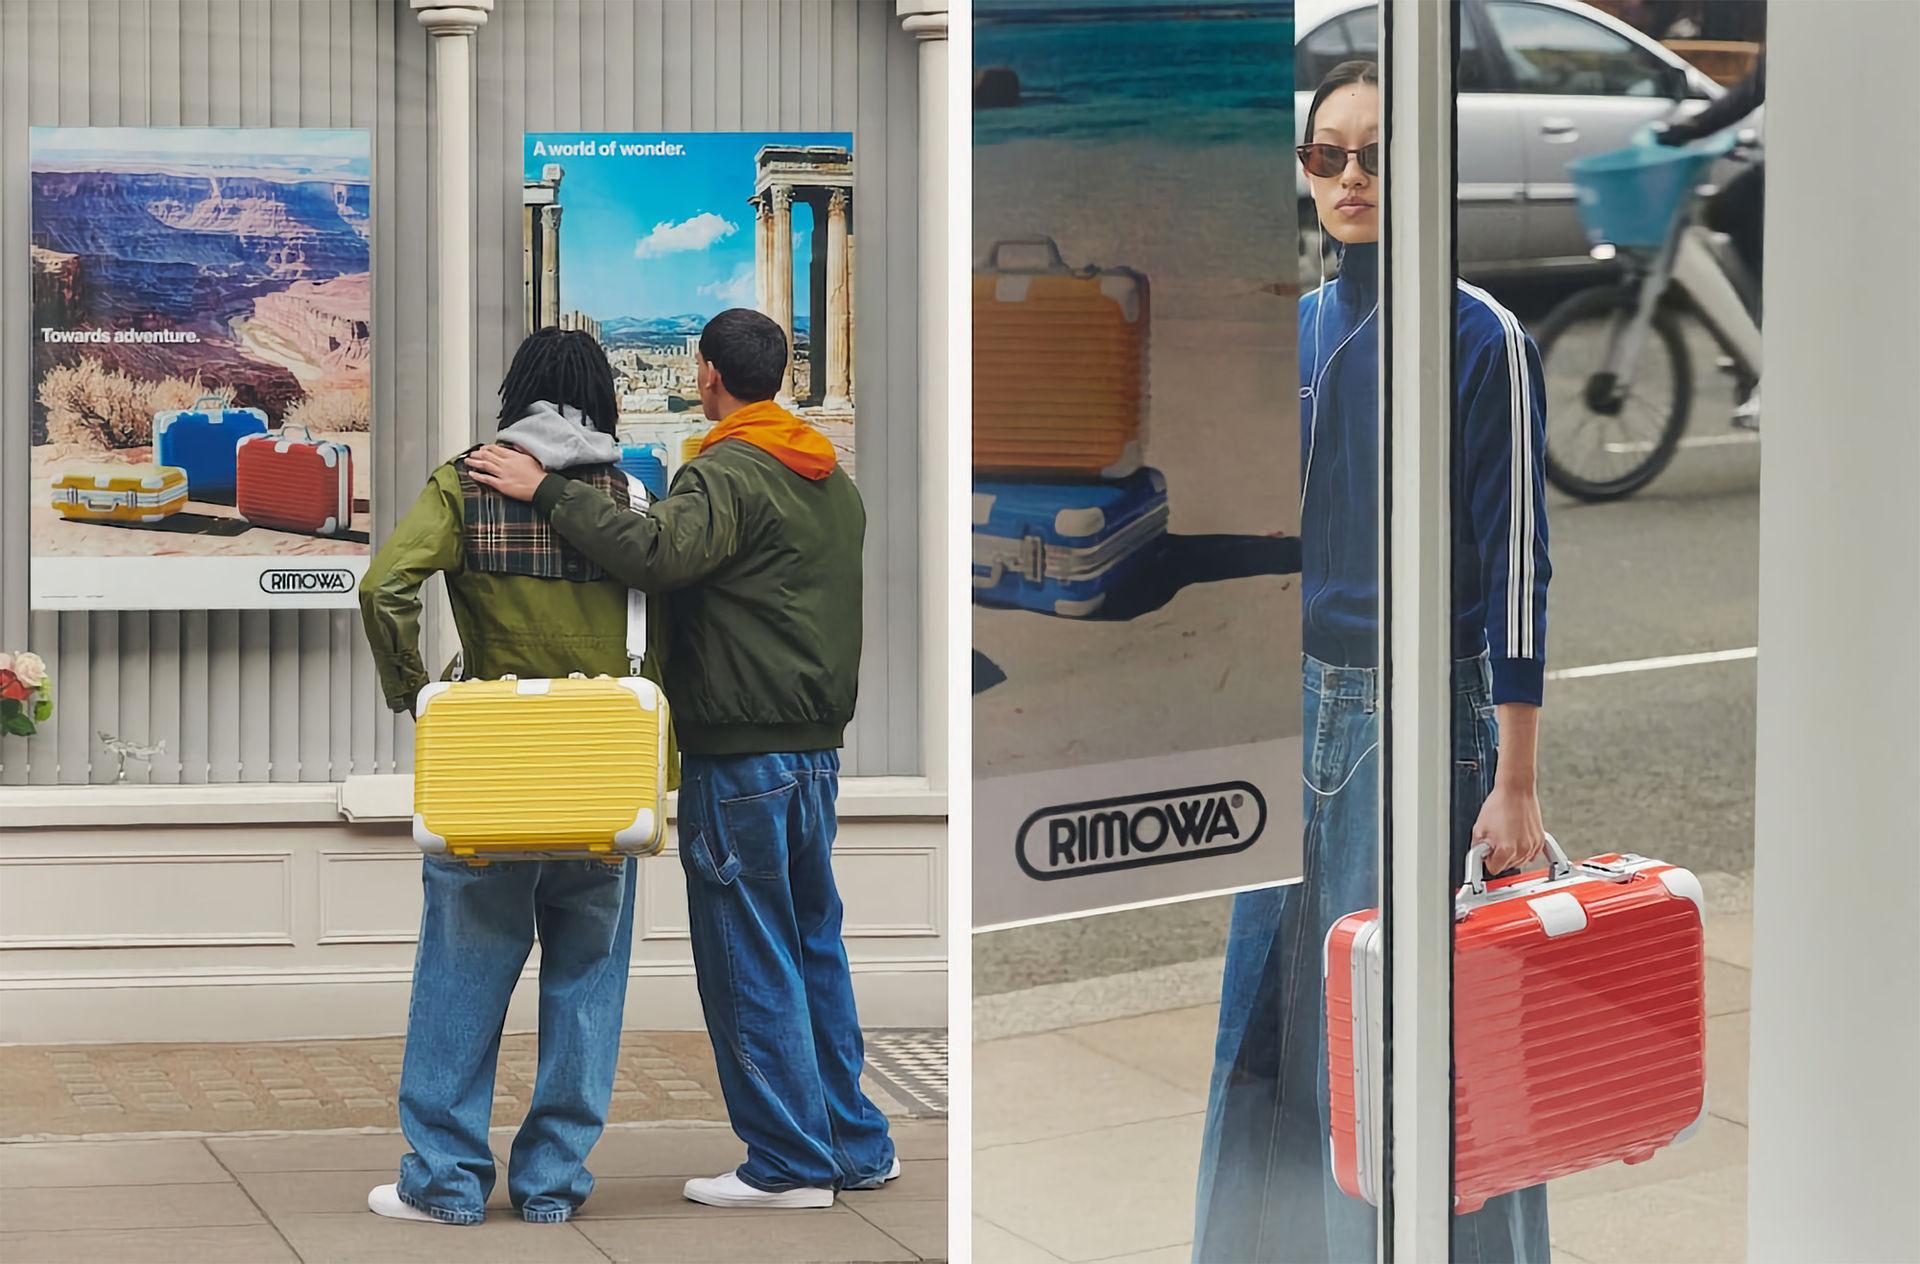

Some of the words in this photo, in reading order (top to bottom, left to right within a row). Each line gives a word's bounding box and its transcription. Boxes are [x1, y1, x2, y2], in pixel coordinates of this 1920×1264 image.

[533, 141, 547, 156] A
[548, 141, 595, 156] world
[599, 141, 617, 156] of
[620, 141, 686, 156] wonder.
[41, 328, 111, 343] Towards
[114, 328, 200, 343] adventure.
